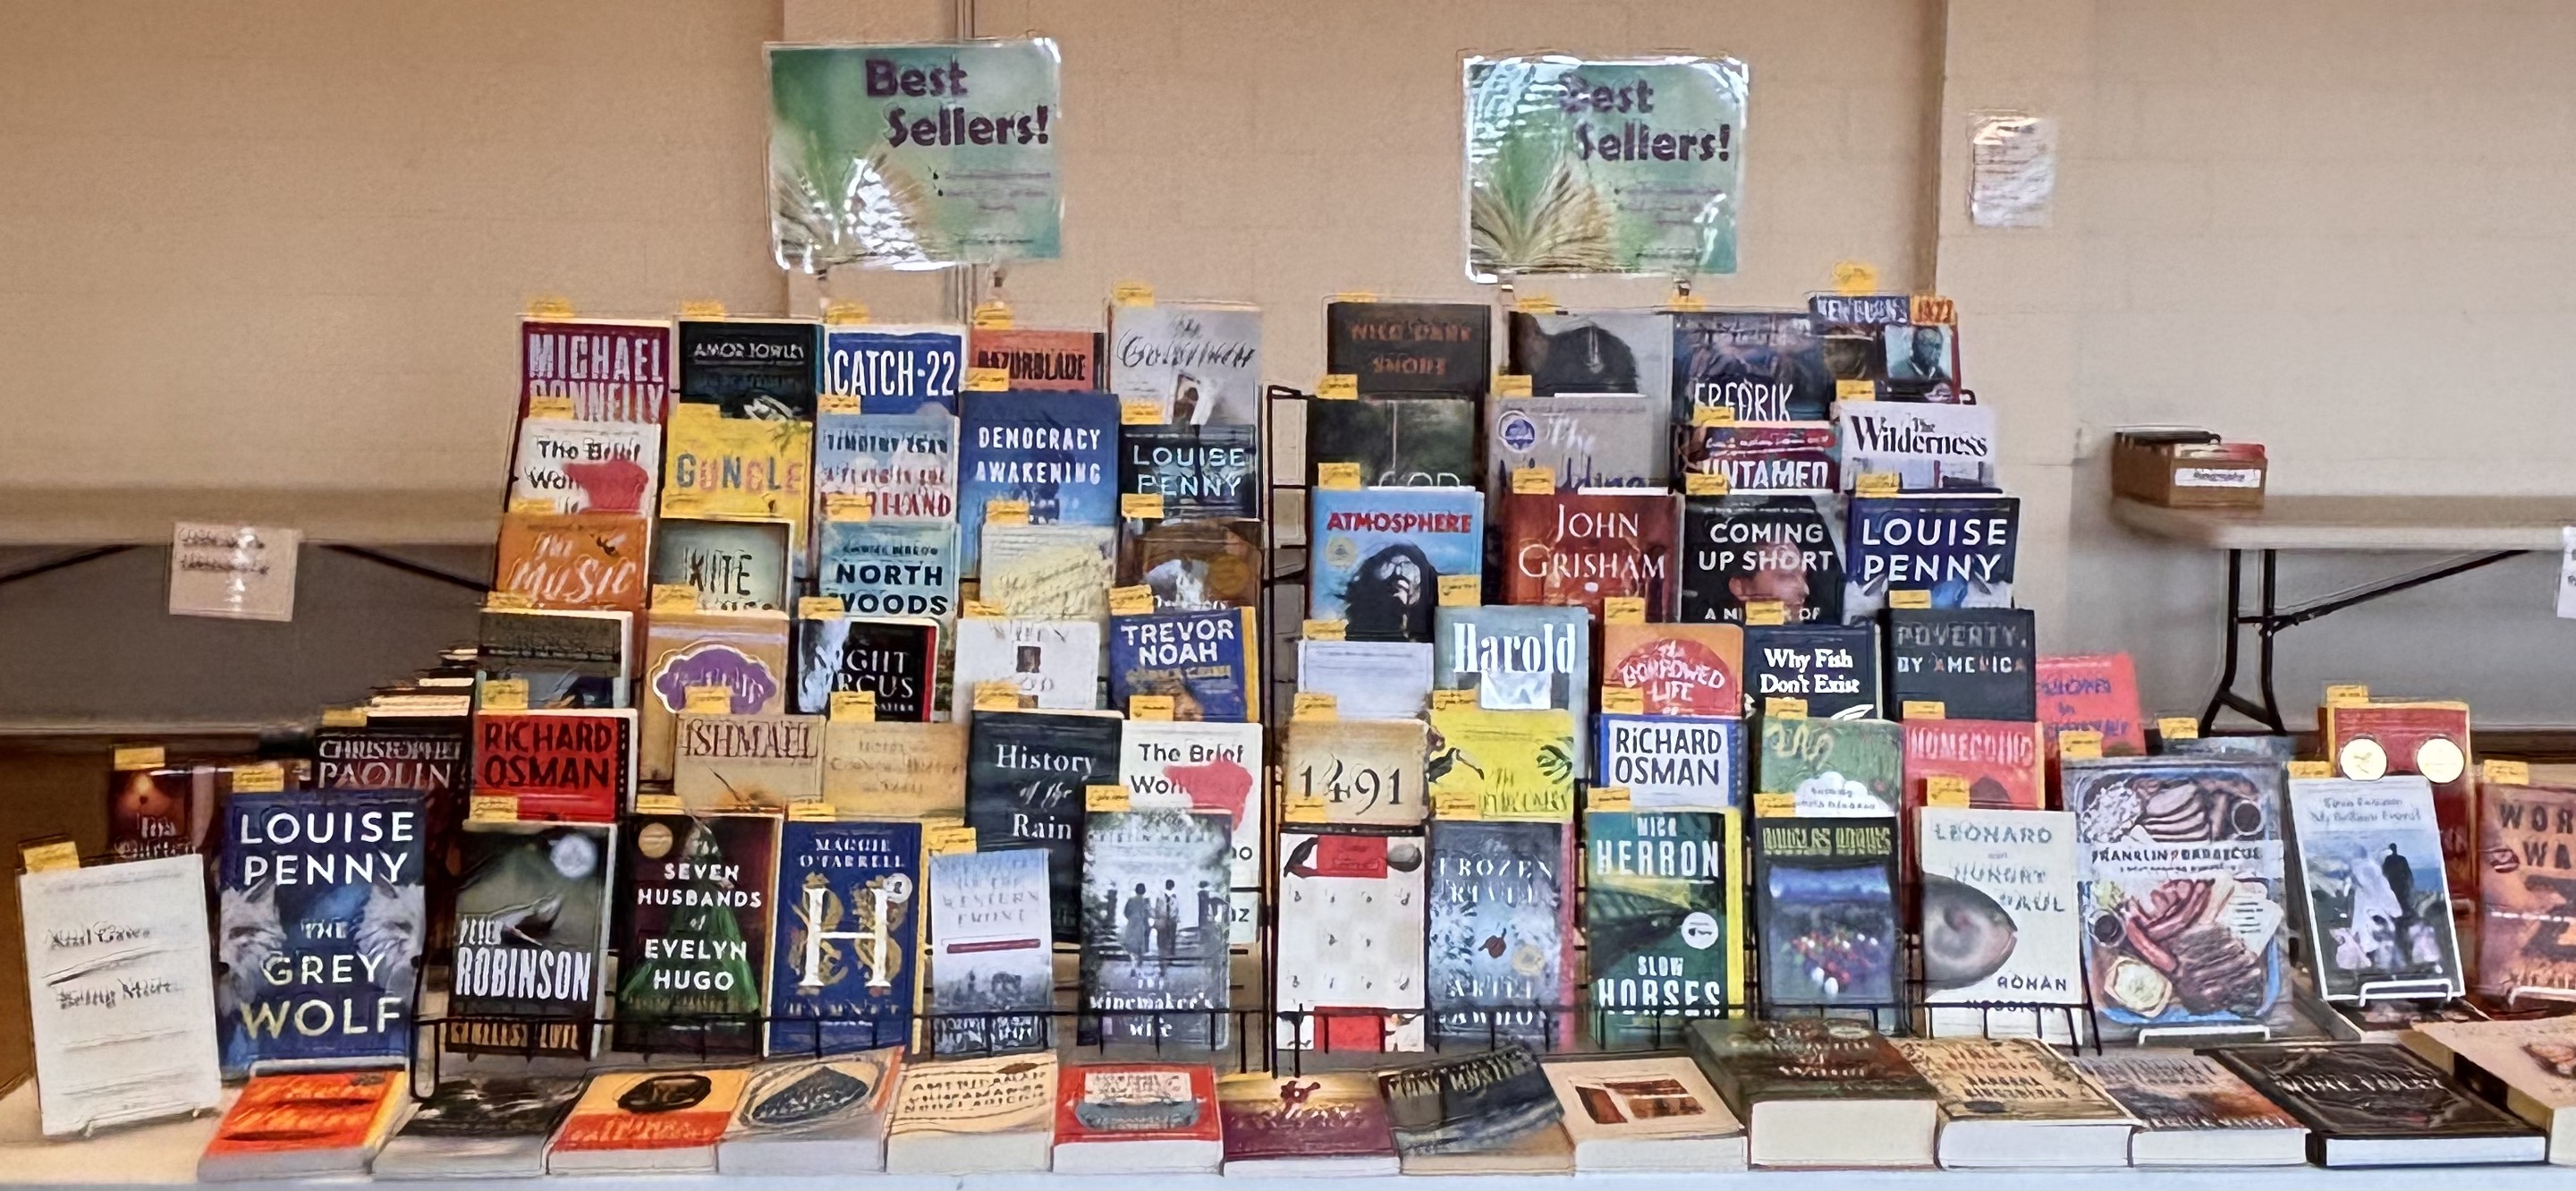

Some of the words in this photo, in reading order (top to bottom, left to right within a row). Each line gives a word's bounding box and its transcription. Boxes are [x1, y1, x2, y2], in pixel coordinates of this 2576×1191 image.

[865, 55, 968, 98] Best
[885, 104, 1049, 148] Sellers!
[1572, 123, 1730, 162] Sellers!
[528, 333, 665, 383] MICHAEL
[833, 348, 955, 397] CATCH-22
[978, 426, 1101, 451] DEMOCRACY
[1851, 415, 1987, 456] Wilderness
[1133, 445, 1246, 467] LOUISE
[675, 452, 803, 495] GUNCLE
[974, 460, 1101, 485] AWAKENING
[1137, 473, 1242, 498] PENNY
[1326, 511, 1473, 533] ATMOSPHERE
[1555, 503, 1640, 542] JOHN
[1709, 523, 1824, 544] COMING
[1862, 518, 2009, 547] LOUISE
[683, 548, 751, 596] KITE
[835, 564, 944, 587] NORTH
[1518, 542, 1666, 581] GRISHAM
[1699, 551, 1734, 572] UP
[1741, 549, 1834, 573] SHORT
[1863, 553, 2002, 583] PENNY
[1120, 619, 1235, 647] TREVOR
[1138, 641, 1218, 666] NOAH
[1453, 623, 1577, 675] Harold
[1763, 648, 1811, 673] Why
[1814, 647, 1854, 669] Fish
[1896, 656, 1923, 674] BY
[1759, 673, 1810, 694] Don't
[484, 720, 613, 753] RICHARD
[681, 718, 818, 758] ISHMAEL
[996, 743, 1096, 781] History
[1138, 743, 1182, 762] The
[483, 754, 610, 789] OSMAN
[1300, 757, 1403, 816] 1491
[1614, 756, 1720, 786] OSMAN
[240, 811, 415, 845] LOUISE
[1013, 812, 1072, 840] Rain
[1934, 821, 2054, 846] LEONARD
[2499, 803, 2574, 835] WOR
[243, 852, 409, 886] PENNY
[1438, 855, 1554, 880] FROZEN
[1596, 838, 1719, 877] HERRON
[2522, 839, 2572, 871] WA
[664, 863, 740, 881] SEVEN
[638, 889, 763, 909] HUSBANDS
[644, 939, 748, 962] EVELYN
[1638, 955, 1684, 977] SLOW
[262, 953, 386, 986] GREY
[454, 948, 593, 1001] ROBINSON
[652, 969, 735, 992] HUGO
[1597, 976, 1721, 1008] HORSES
[240, 996, 402, 1039] WOLF
